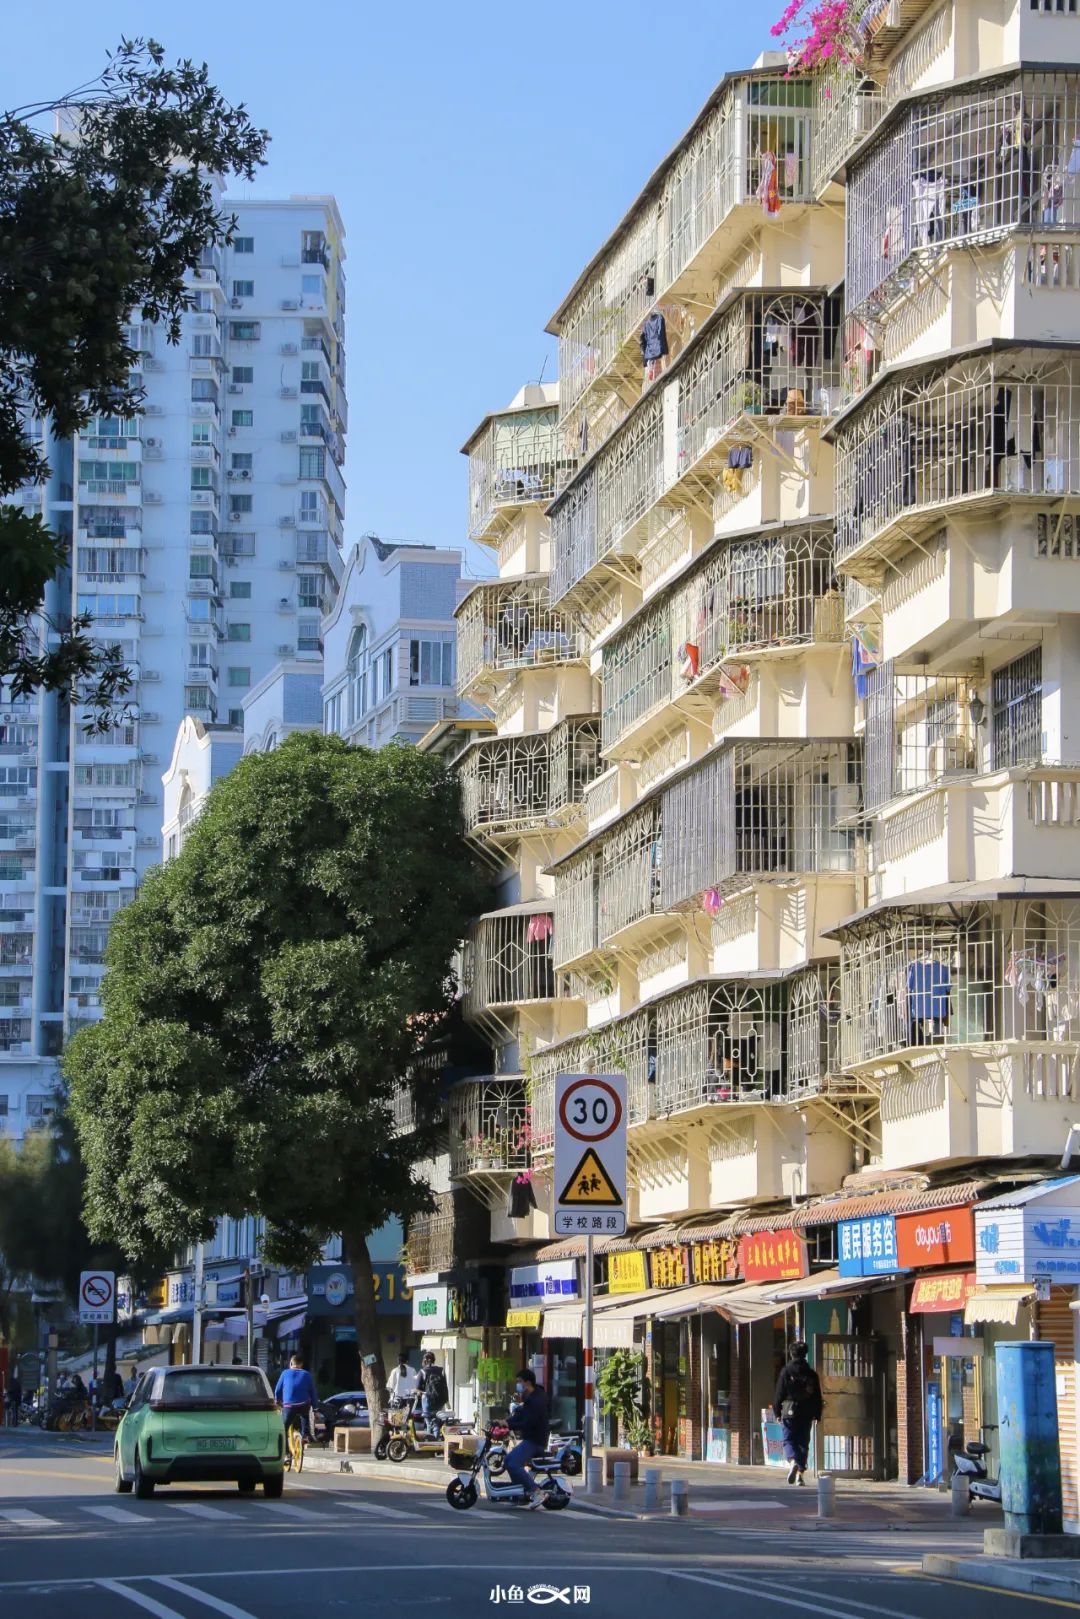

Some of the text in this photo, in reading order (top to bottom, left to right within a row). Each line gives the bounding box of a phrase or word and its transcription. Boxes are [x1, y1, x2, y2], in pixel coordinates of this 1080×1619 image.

[573, 1097, 608, 1125] 30
[562, 1215, 617, 1230] 学校路段
[842, 1219, 898, 1261] 便民服务咨
